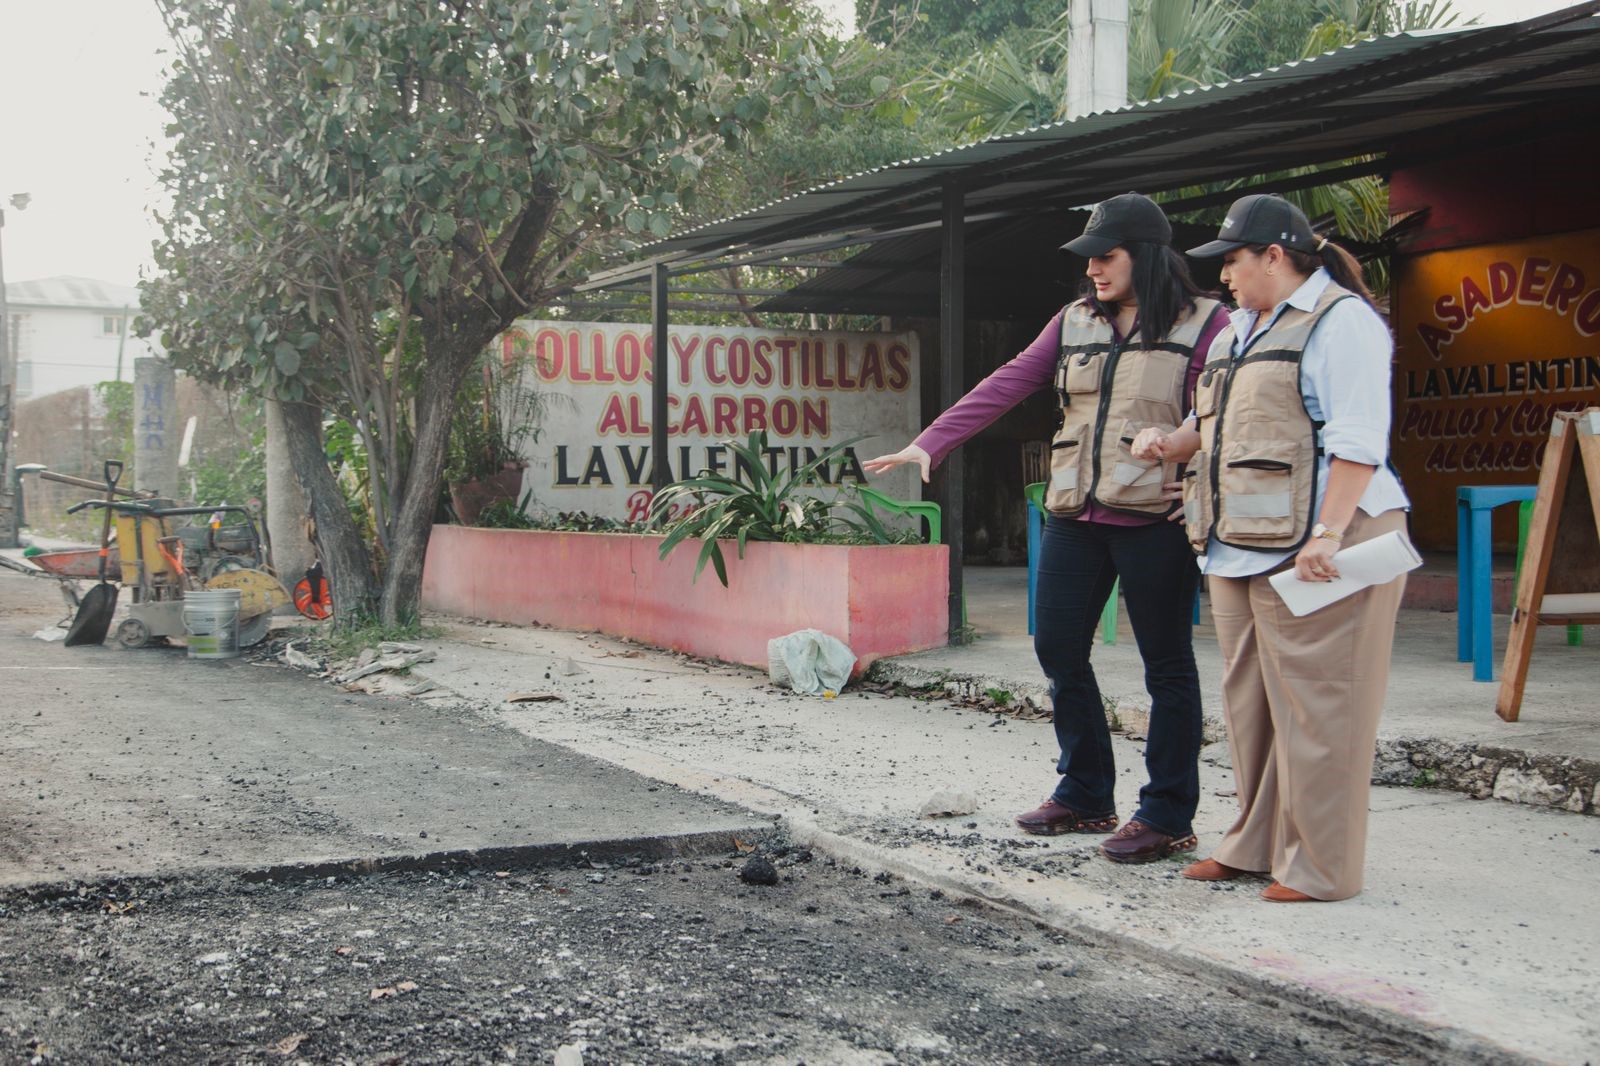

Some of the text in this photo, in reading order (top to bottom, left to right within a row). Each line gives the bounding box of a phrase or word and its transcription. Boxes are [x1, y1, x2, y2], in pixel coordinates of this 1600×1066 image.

[1416, 257, 1600, 361] ASADERO
[668, 332, 702, 387] Y
[703, 335, 911, 392] COSTILLAS
[597, 393, 652, 436] AL
[1399, 403, 1489, 441] POLLOS
